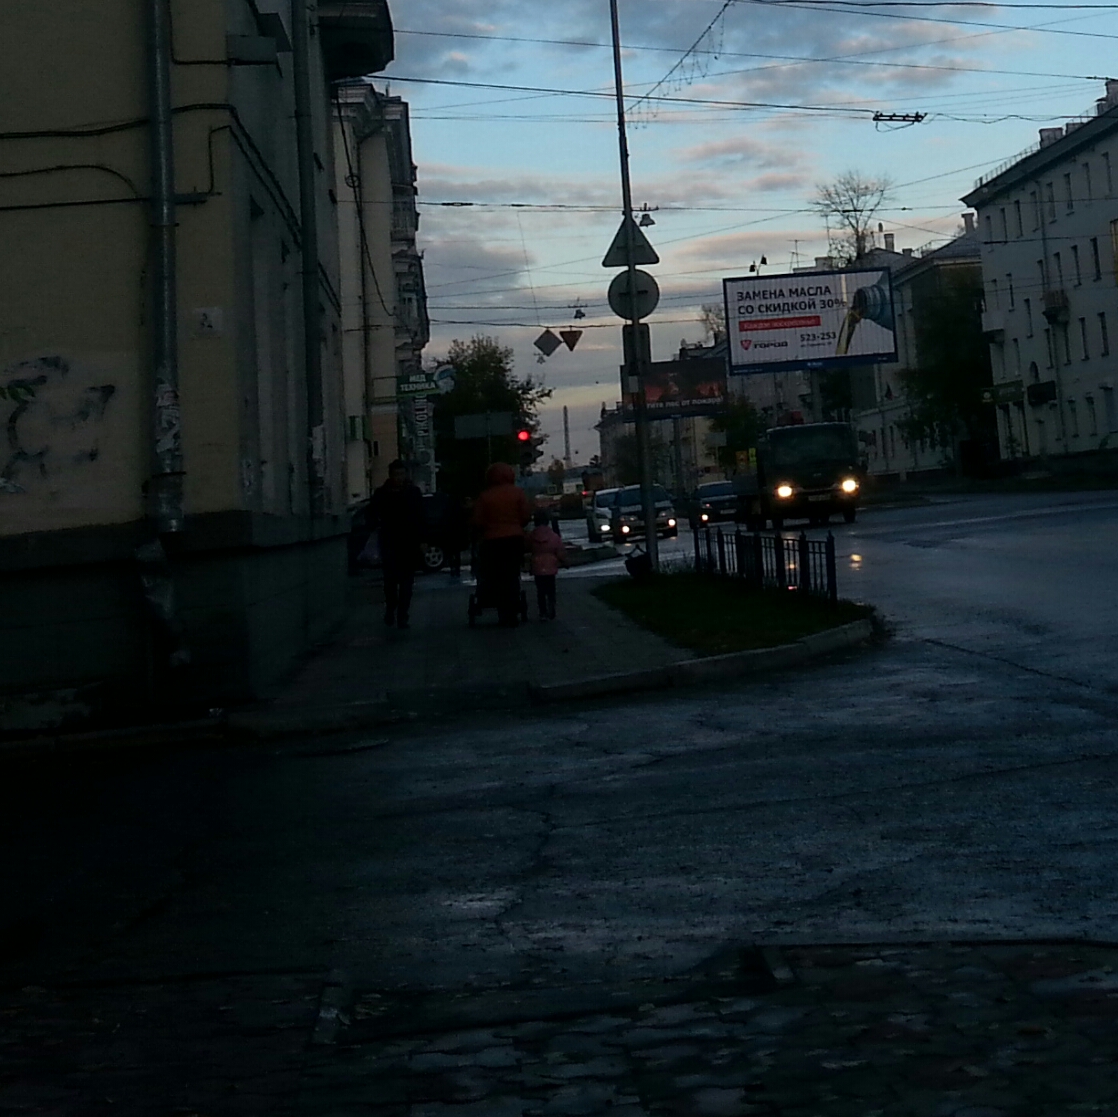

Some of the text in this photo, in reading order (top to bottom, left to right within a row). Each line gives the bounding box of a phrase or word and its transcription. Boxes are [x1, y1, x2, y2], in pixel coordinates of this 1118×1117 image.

[737, 286, 832, 302] ЗАМЕНА МАСЛА
[738, 297, 848, 315] СО СКИДКОЙ 30%
